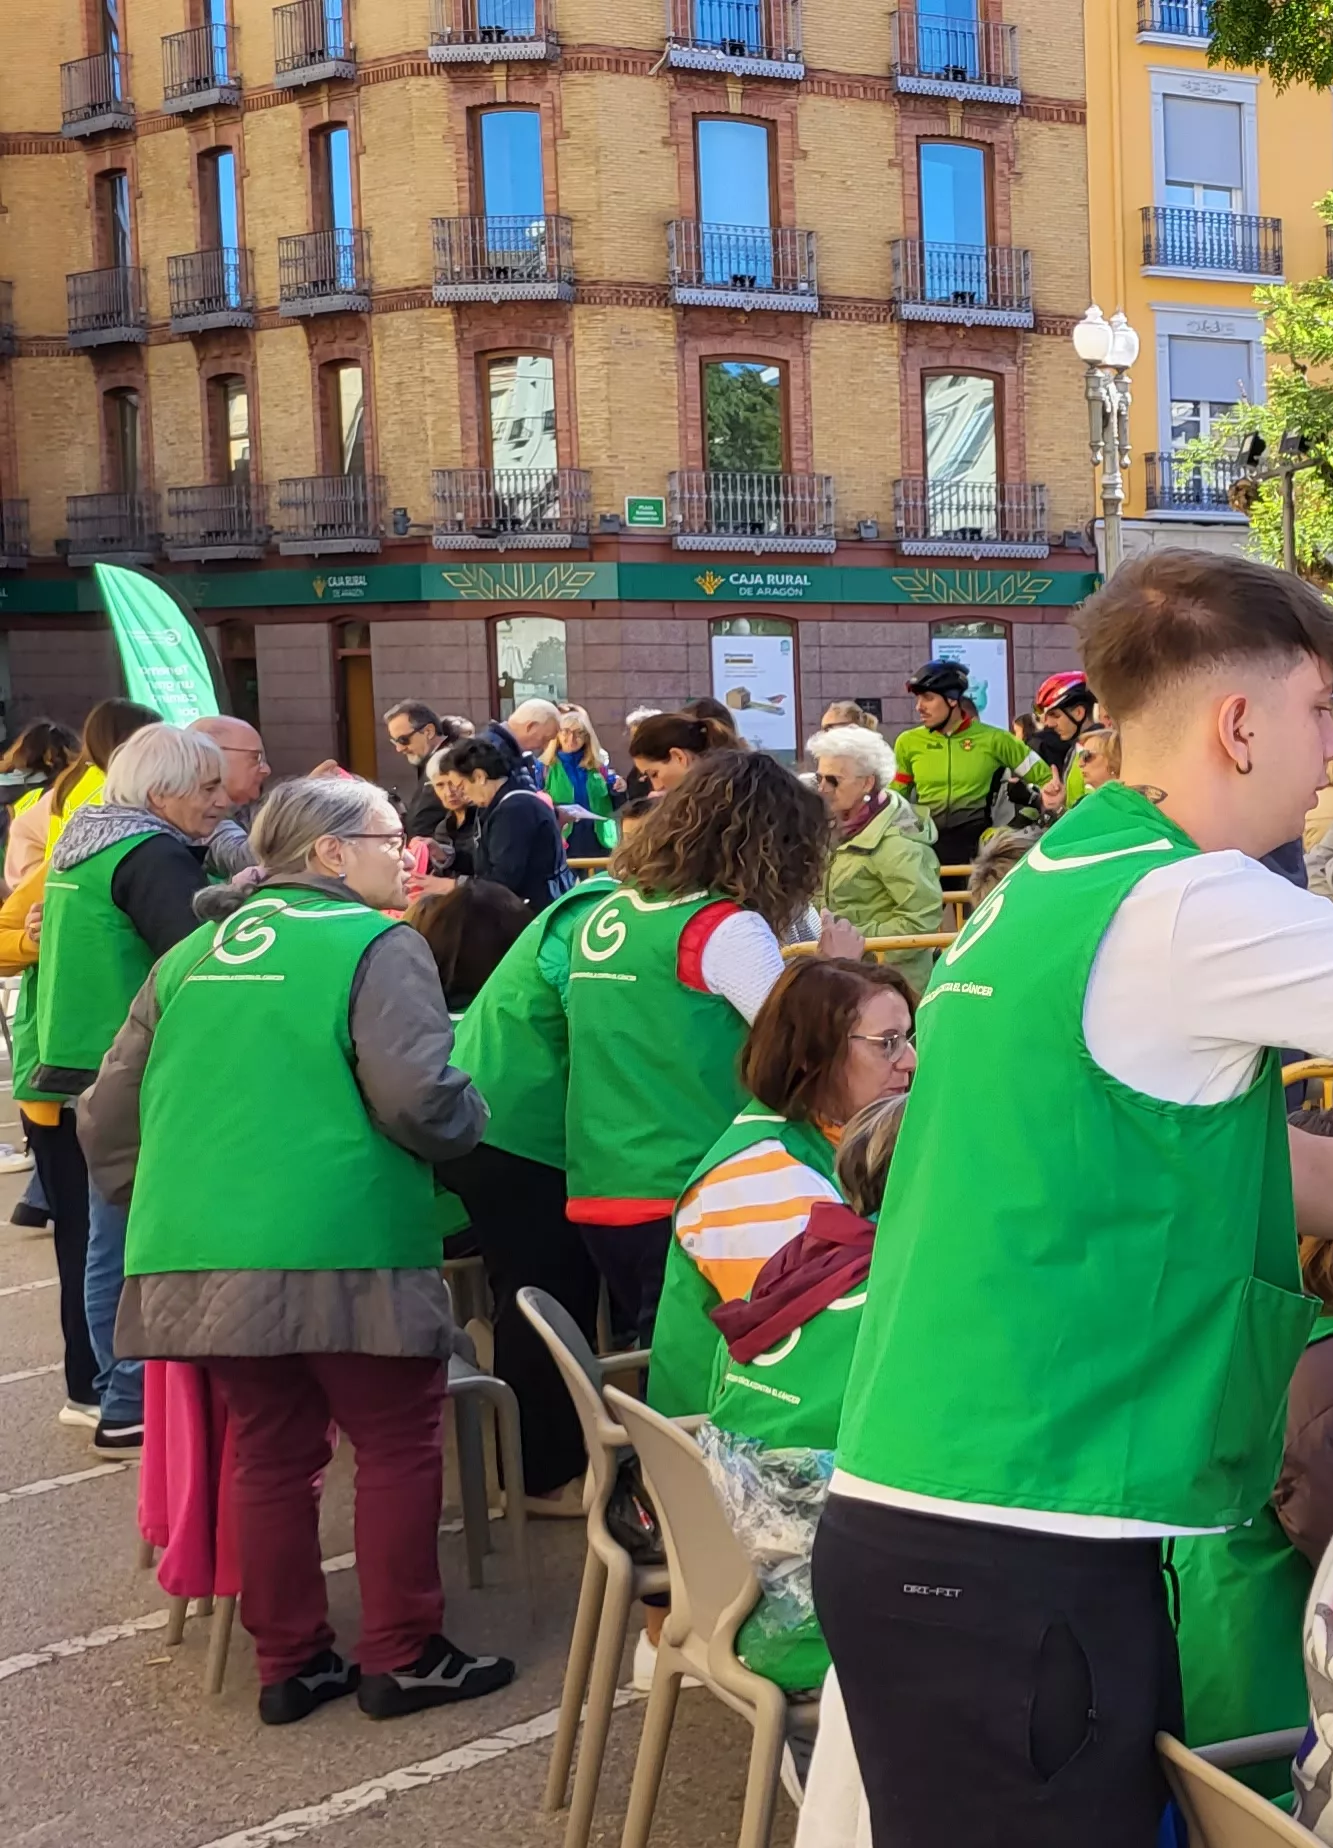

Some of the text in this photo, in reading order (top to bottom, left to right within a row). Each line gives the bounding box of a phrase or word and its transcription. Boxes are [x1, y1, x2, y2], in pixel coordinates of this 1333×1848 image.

[328, 575, 368, 587] CAJA RURAL
[729, 573, 811, 586] CAJA RURAL
[739, 587, 753, 596] DE
[903, 1583, 963, 1598] DRI-FIT
